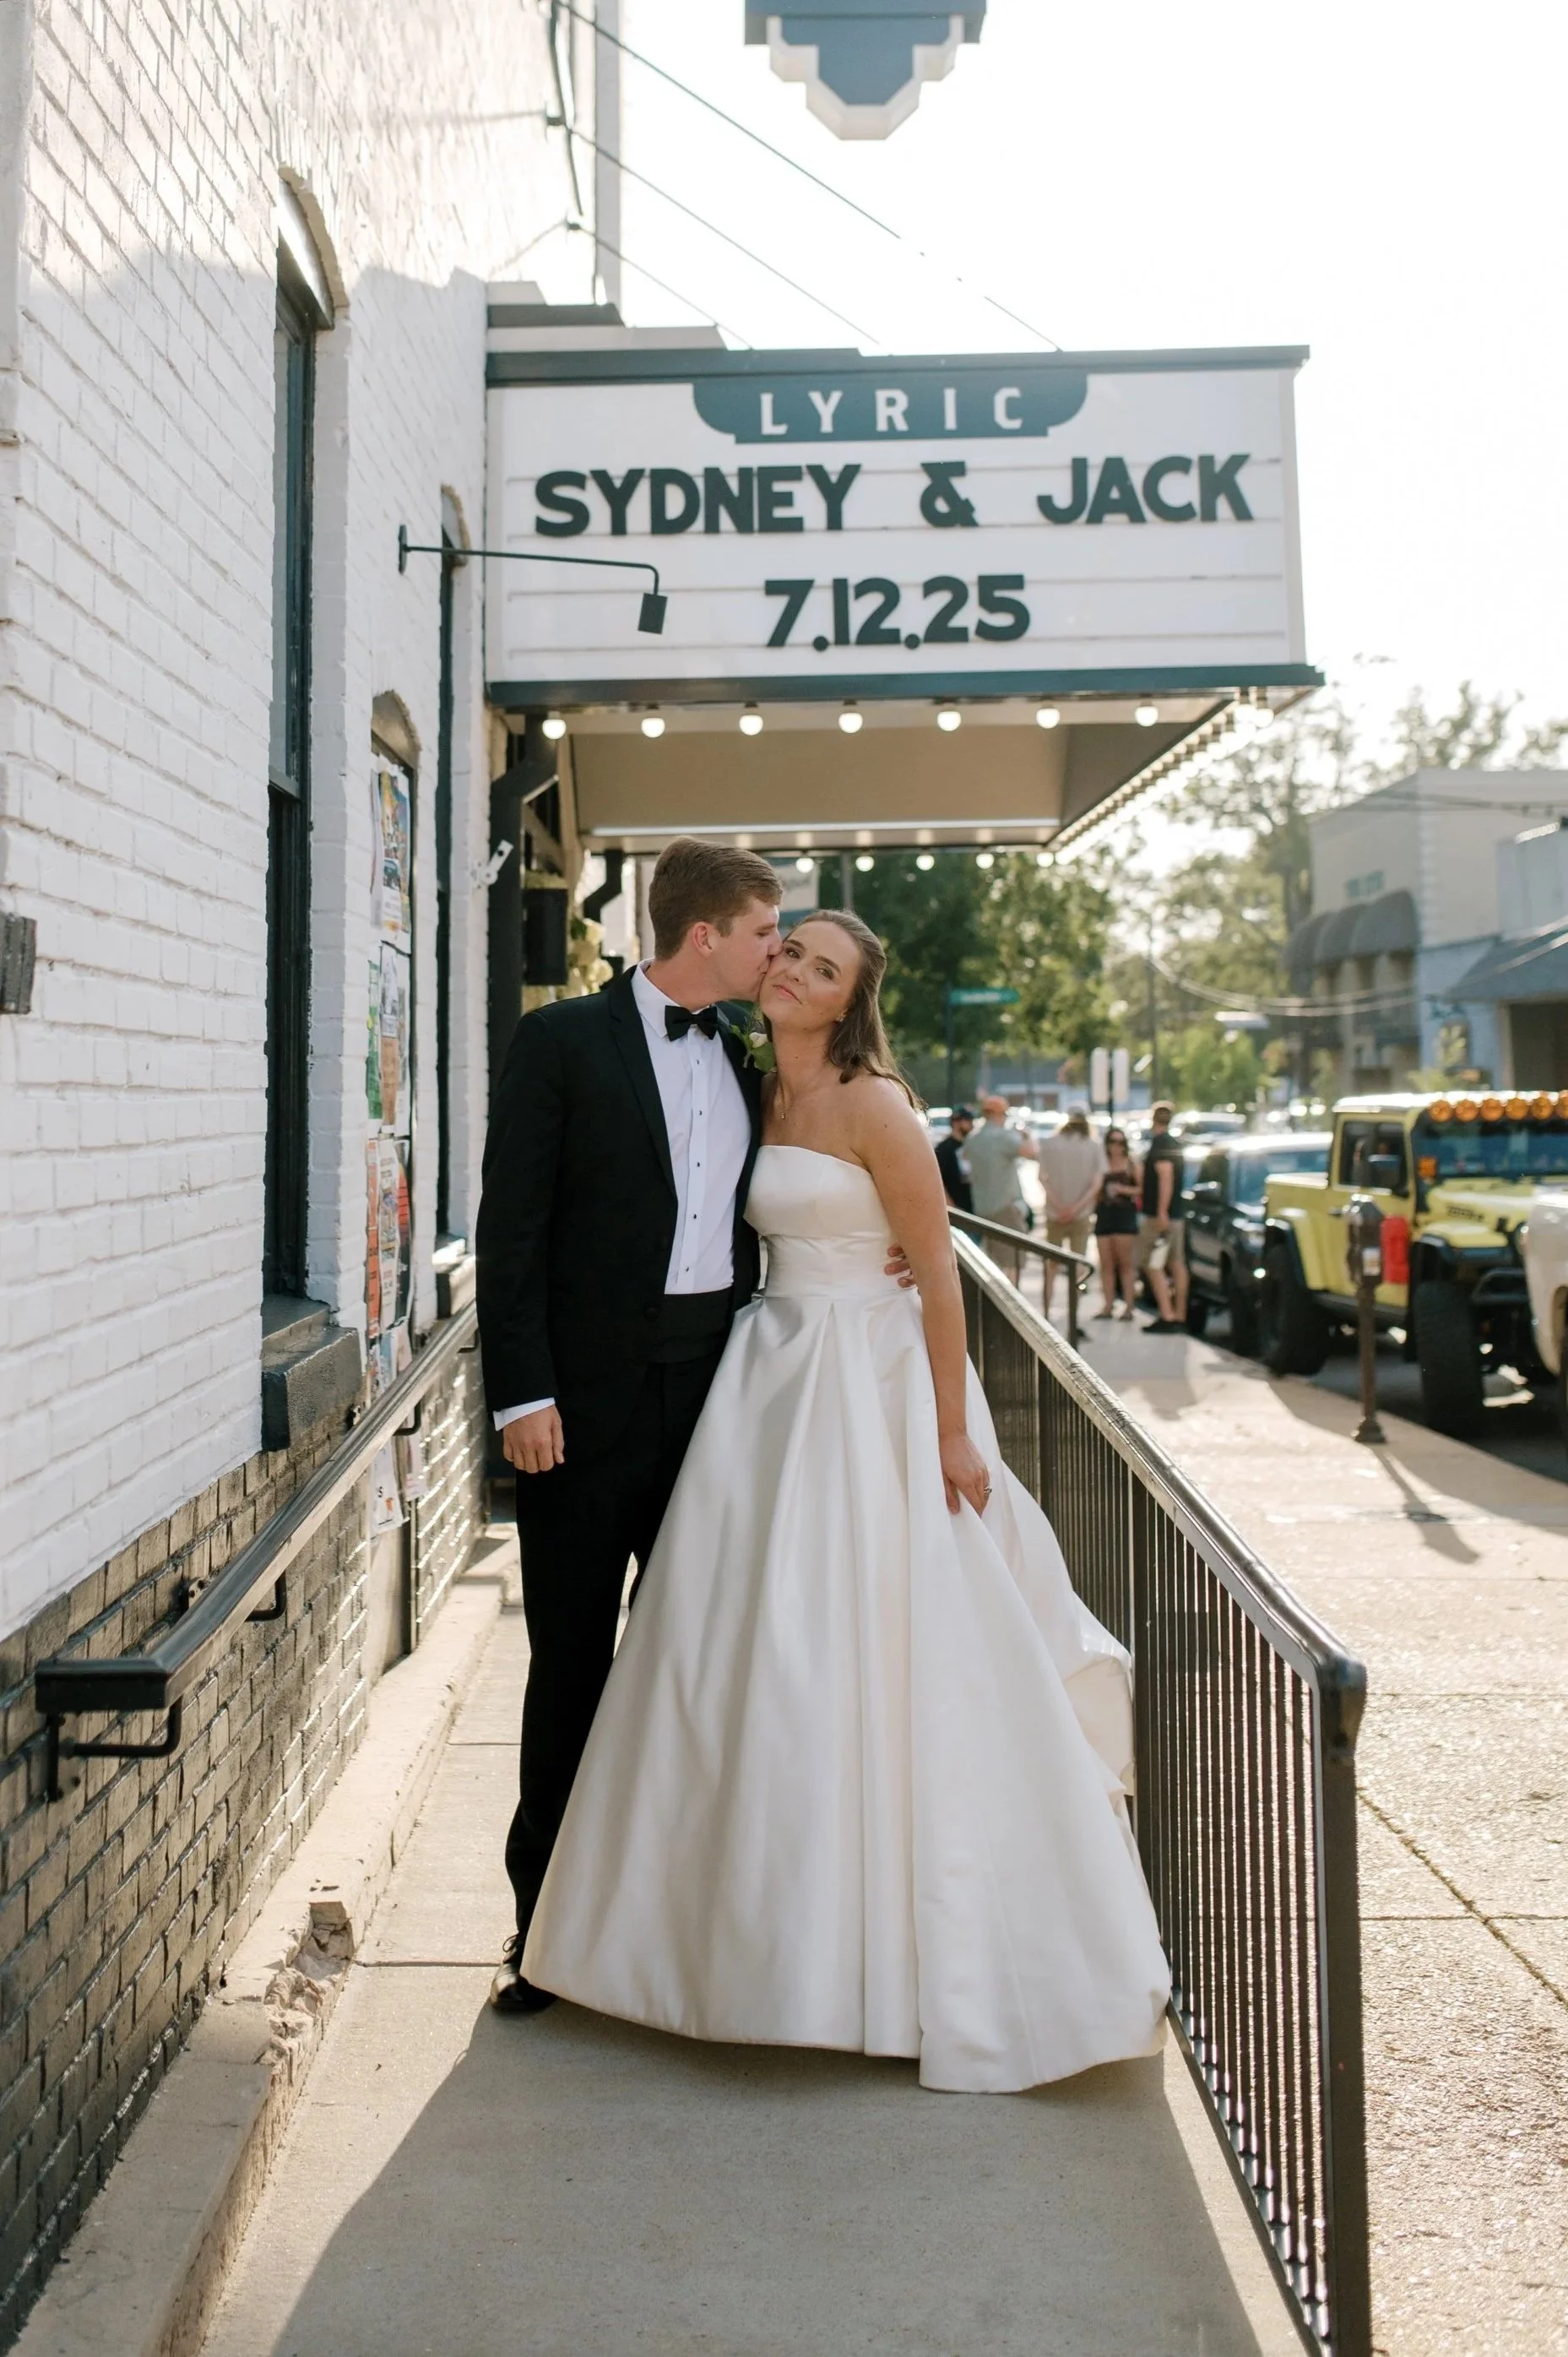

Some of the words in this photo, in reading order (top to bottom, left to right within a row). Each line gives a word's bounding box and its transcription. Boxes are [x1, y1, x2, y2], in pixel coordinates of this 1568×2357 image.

[760, 386, 1024, 436] LYRIC
[534, 463, 862, 538] SYDNEY
[919, 461, 979, 530] &
[1036, 454, 1254, 525] JACK
[763, 574, 1031, 653] 7.12.25
